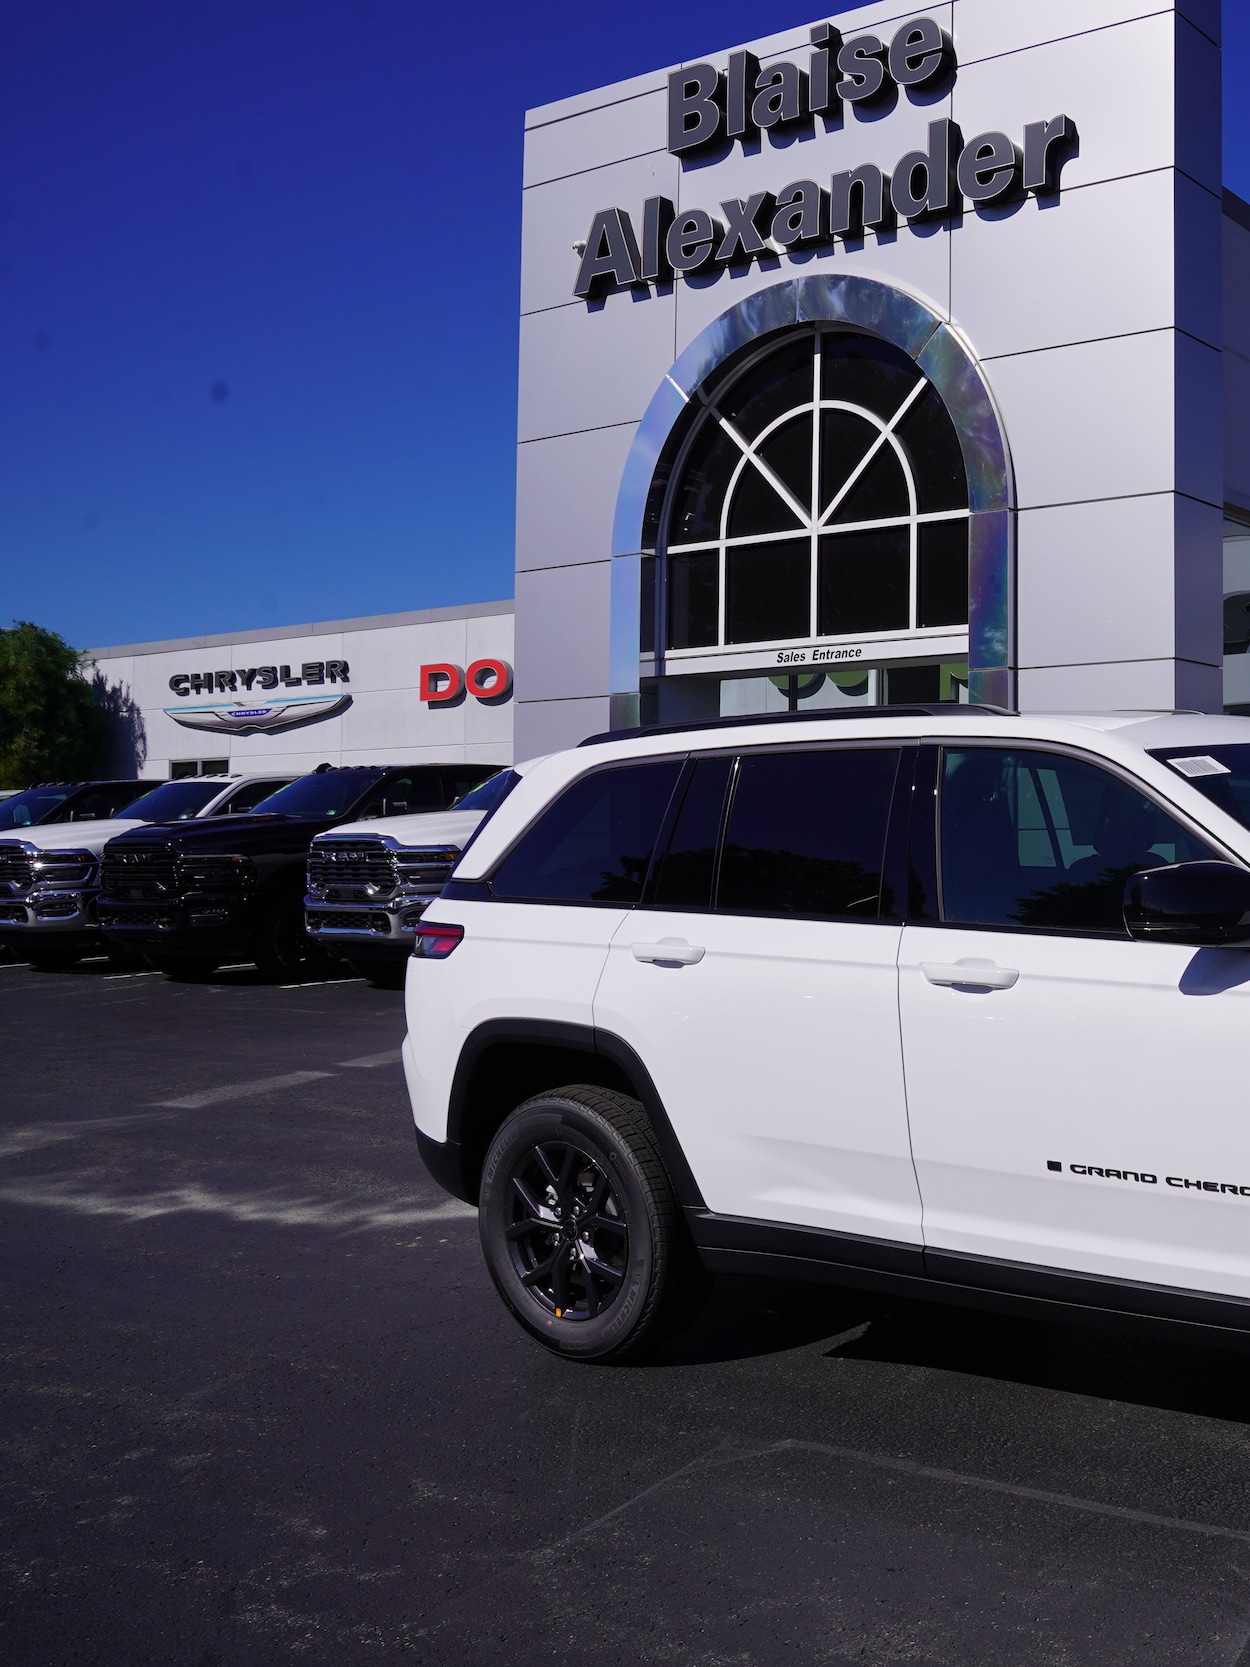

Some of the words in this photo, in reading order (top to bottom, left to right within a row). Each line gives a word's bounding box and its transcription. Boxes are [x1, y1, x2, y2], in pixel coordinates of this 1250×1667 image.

[666, 17, 955, 160] Blaise
[572, 113, 1079, 301] Alexander
[776, 651, 806, 663] Sales
[811, 648, 862, 661] Entrance
[169, 660, 350, 697] CHRYSLER
[420, 659, 513, 703] DO
[231, 709, 270, 717] CHRYSLER
[1069, 1164, 1158, 1184] GRAND
